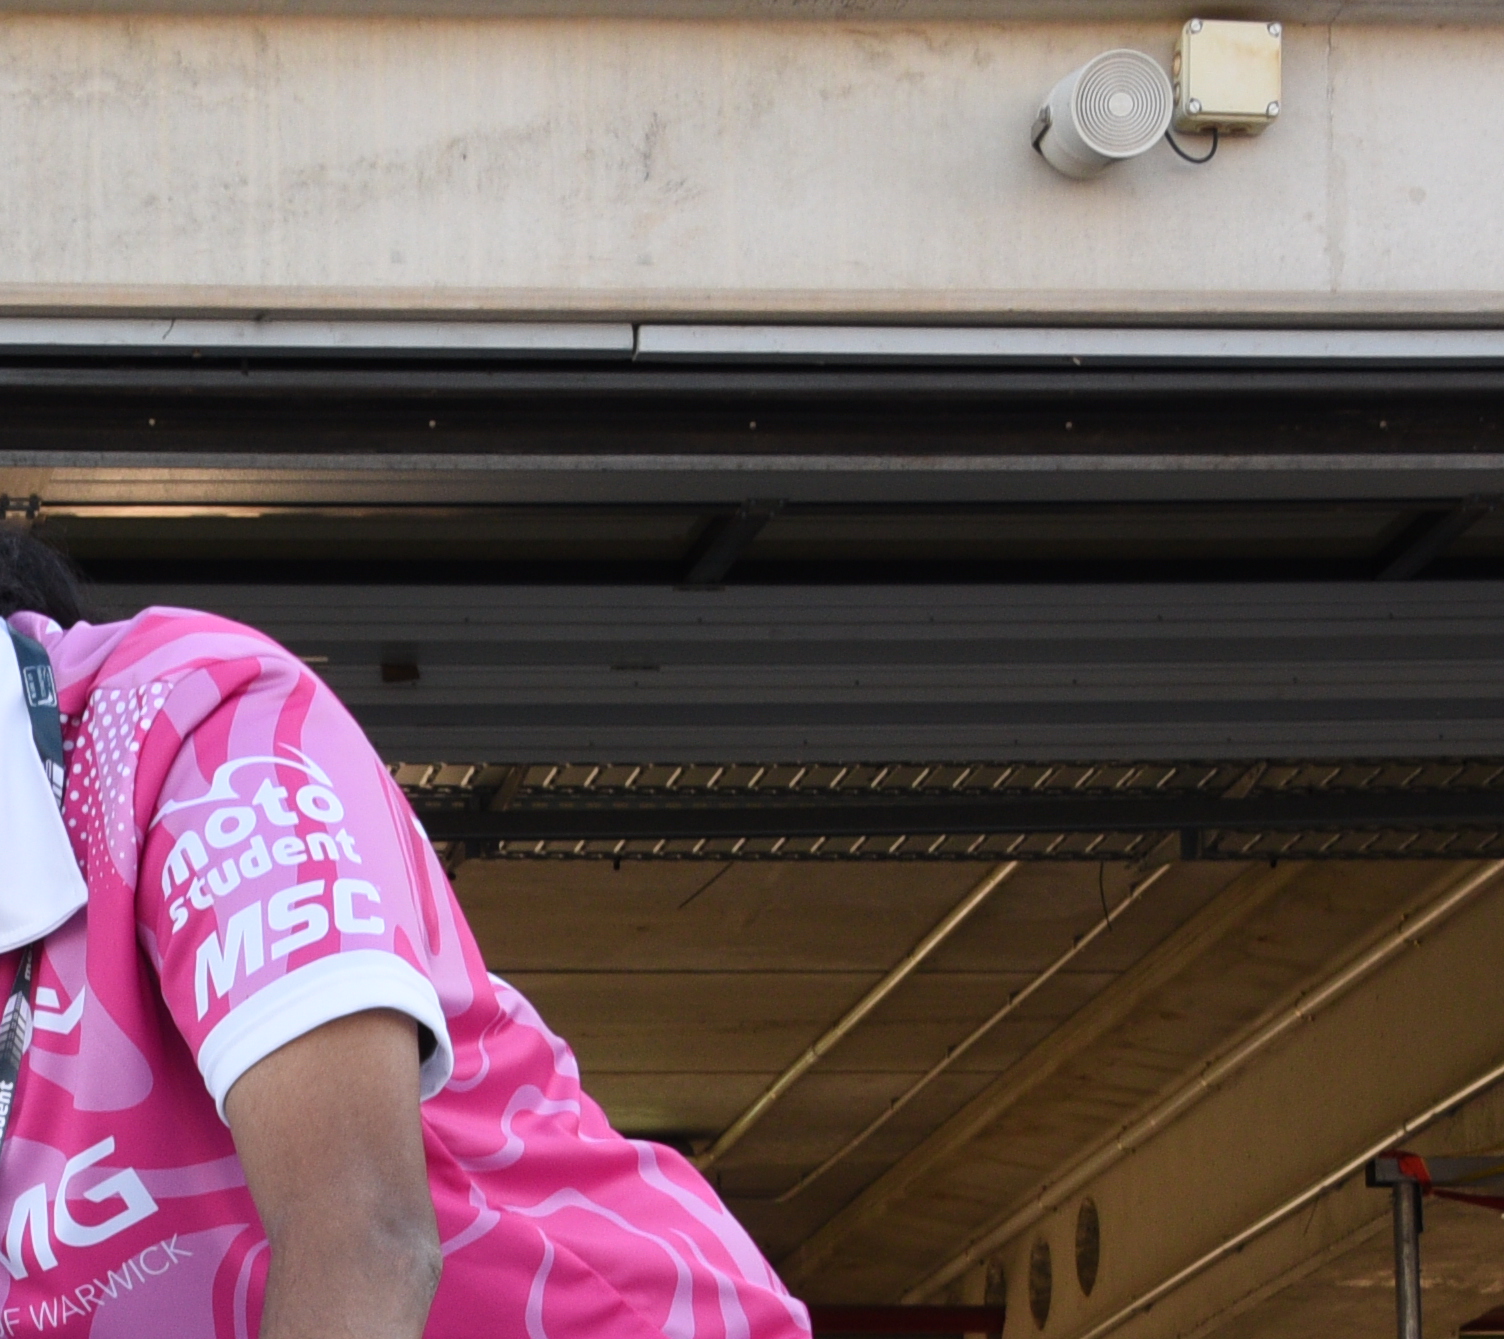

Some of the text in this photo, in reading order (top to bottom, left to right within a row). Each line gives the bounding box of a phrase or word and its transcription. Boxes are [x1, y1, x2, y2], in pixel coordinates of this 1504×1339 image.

[162, 777, 344, 901] moto
[169, 828, 362, 934] student
[195, 878, 385, 1022] MSC
[30, 1233, 192, 1331] WARWICK
